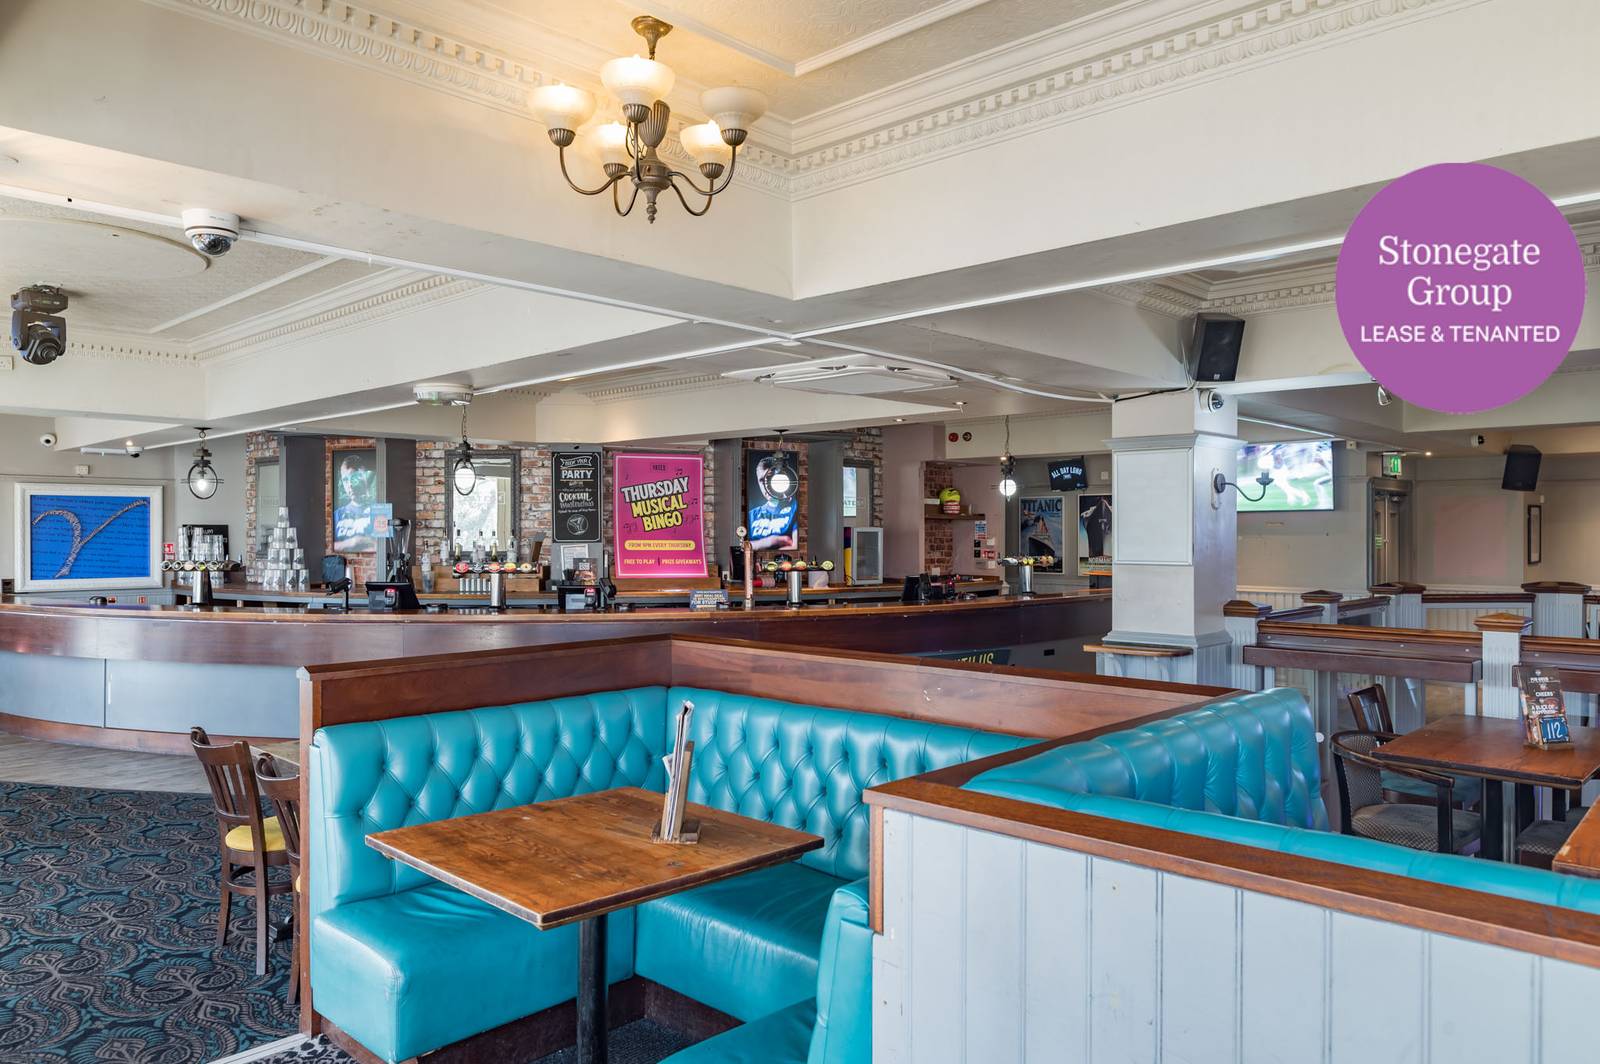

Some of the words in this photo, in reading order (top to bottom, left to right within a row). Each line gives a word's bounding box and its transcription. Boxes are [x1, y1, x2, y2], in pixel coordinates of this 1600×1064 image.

[561, 470, 592, 479] PARTY
[1051, 470, 1061, 479] ALL
[1060, 466, 1070, 475] DAY
[621, 477, 689, 502] THURSDAY
[631, 494, 688, 517] MUSICAL
[1021, 499, 1062, 512] TITANIC
[643, 511, 683, 531] BINGO
[1547, 721, 1564, 739] 112
